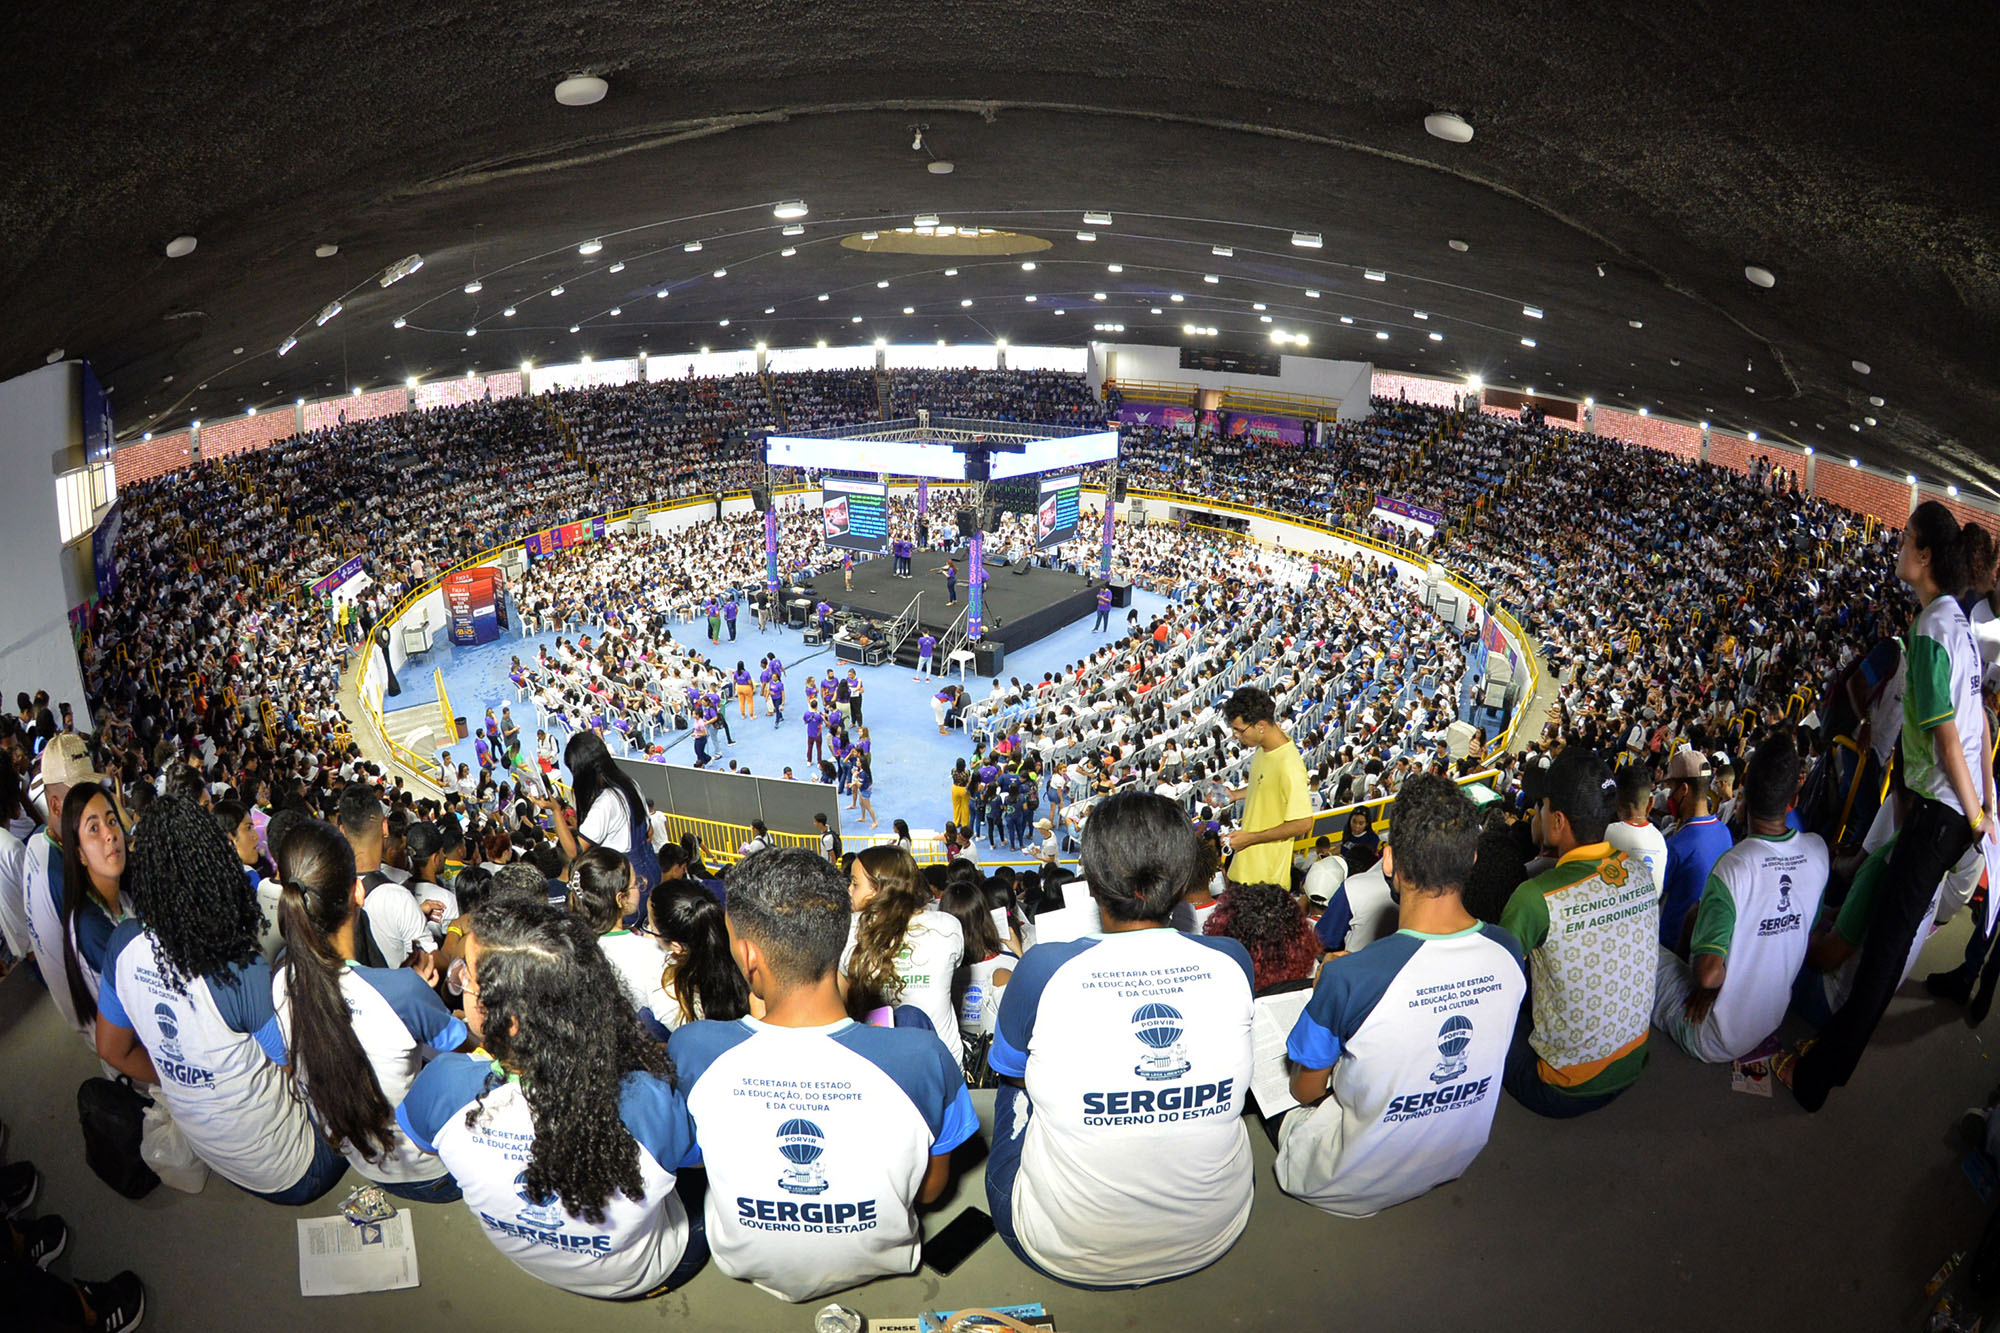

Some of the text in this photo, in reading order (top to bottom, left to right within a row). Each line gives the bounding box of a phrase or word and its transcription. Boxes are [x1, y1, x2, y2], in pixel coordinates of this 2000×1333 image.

[1564, 896, 1616, 917] TÉCNICO
[1566, 920, 1585, 934] EM
[1759, 914, 1802, 930] SERGIPE
[1091, 964, 1200, 979] SECRETARIA DE ESTADO
[1082, 982, 1096, 990] DA
[1098, 978, 1155, 988] EDUCAÇÃO,
[1174, 972, 1212, 984] ESPORTE
[1416, 974, 1494, 996] SECRETARIA DE ESTADO
[1118, 986, 1184, 998] E DA CULTURA
[1408, 983, 1502, 1008] DA EDUCAÇÃO, DO ESPORTE
[1434, 998, 1480, 1014] E DA CULTURA
[1141, 1019, 1175, 1028] PORVIR
[155, 1057, 215, 1085] RGIPE
[742, 1078, 798, 1088] SECRETARIA
[815, 1082, 852, 1090] ESTADO
[733, 1088, 746, 1096] DA
[748, 1090, 802, 1100] EDUCAÇÃO,
[822, 1093, 862, 1101] ESPORTE
[1083, 1077, 1234, 1115] SERGIPE
[1386, 1075, 1492, 1116] SERGIPE
[766, 1102, 830, 1112] E DA CULTURA
[1083, 1102, 1231, 1127] GOVERNO DO ESTADO
[1383, 1094, 1485, 1123] GOVERNO DO ESTADO
[482, 1128, 534, 1141] SECRETARIA
[785, 1136, 817, 1144] PORVIR
[472, 1136, 532, 1152] DA EDUCAÇÃ
[511, 1154, 524, 1162] DA
[736, 1196, 877, 1224] SERGIPE
[480, 1211, 612, 1251] SERGIPE
[739, 1218, 877, 1234] GOVERNO DO ESTADO
